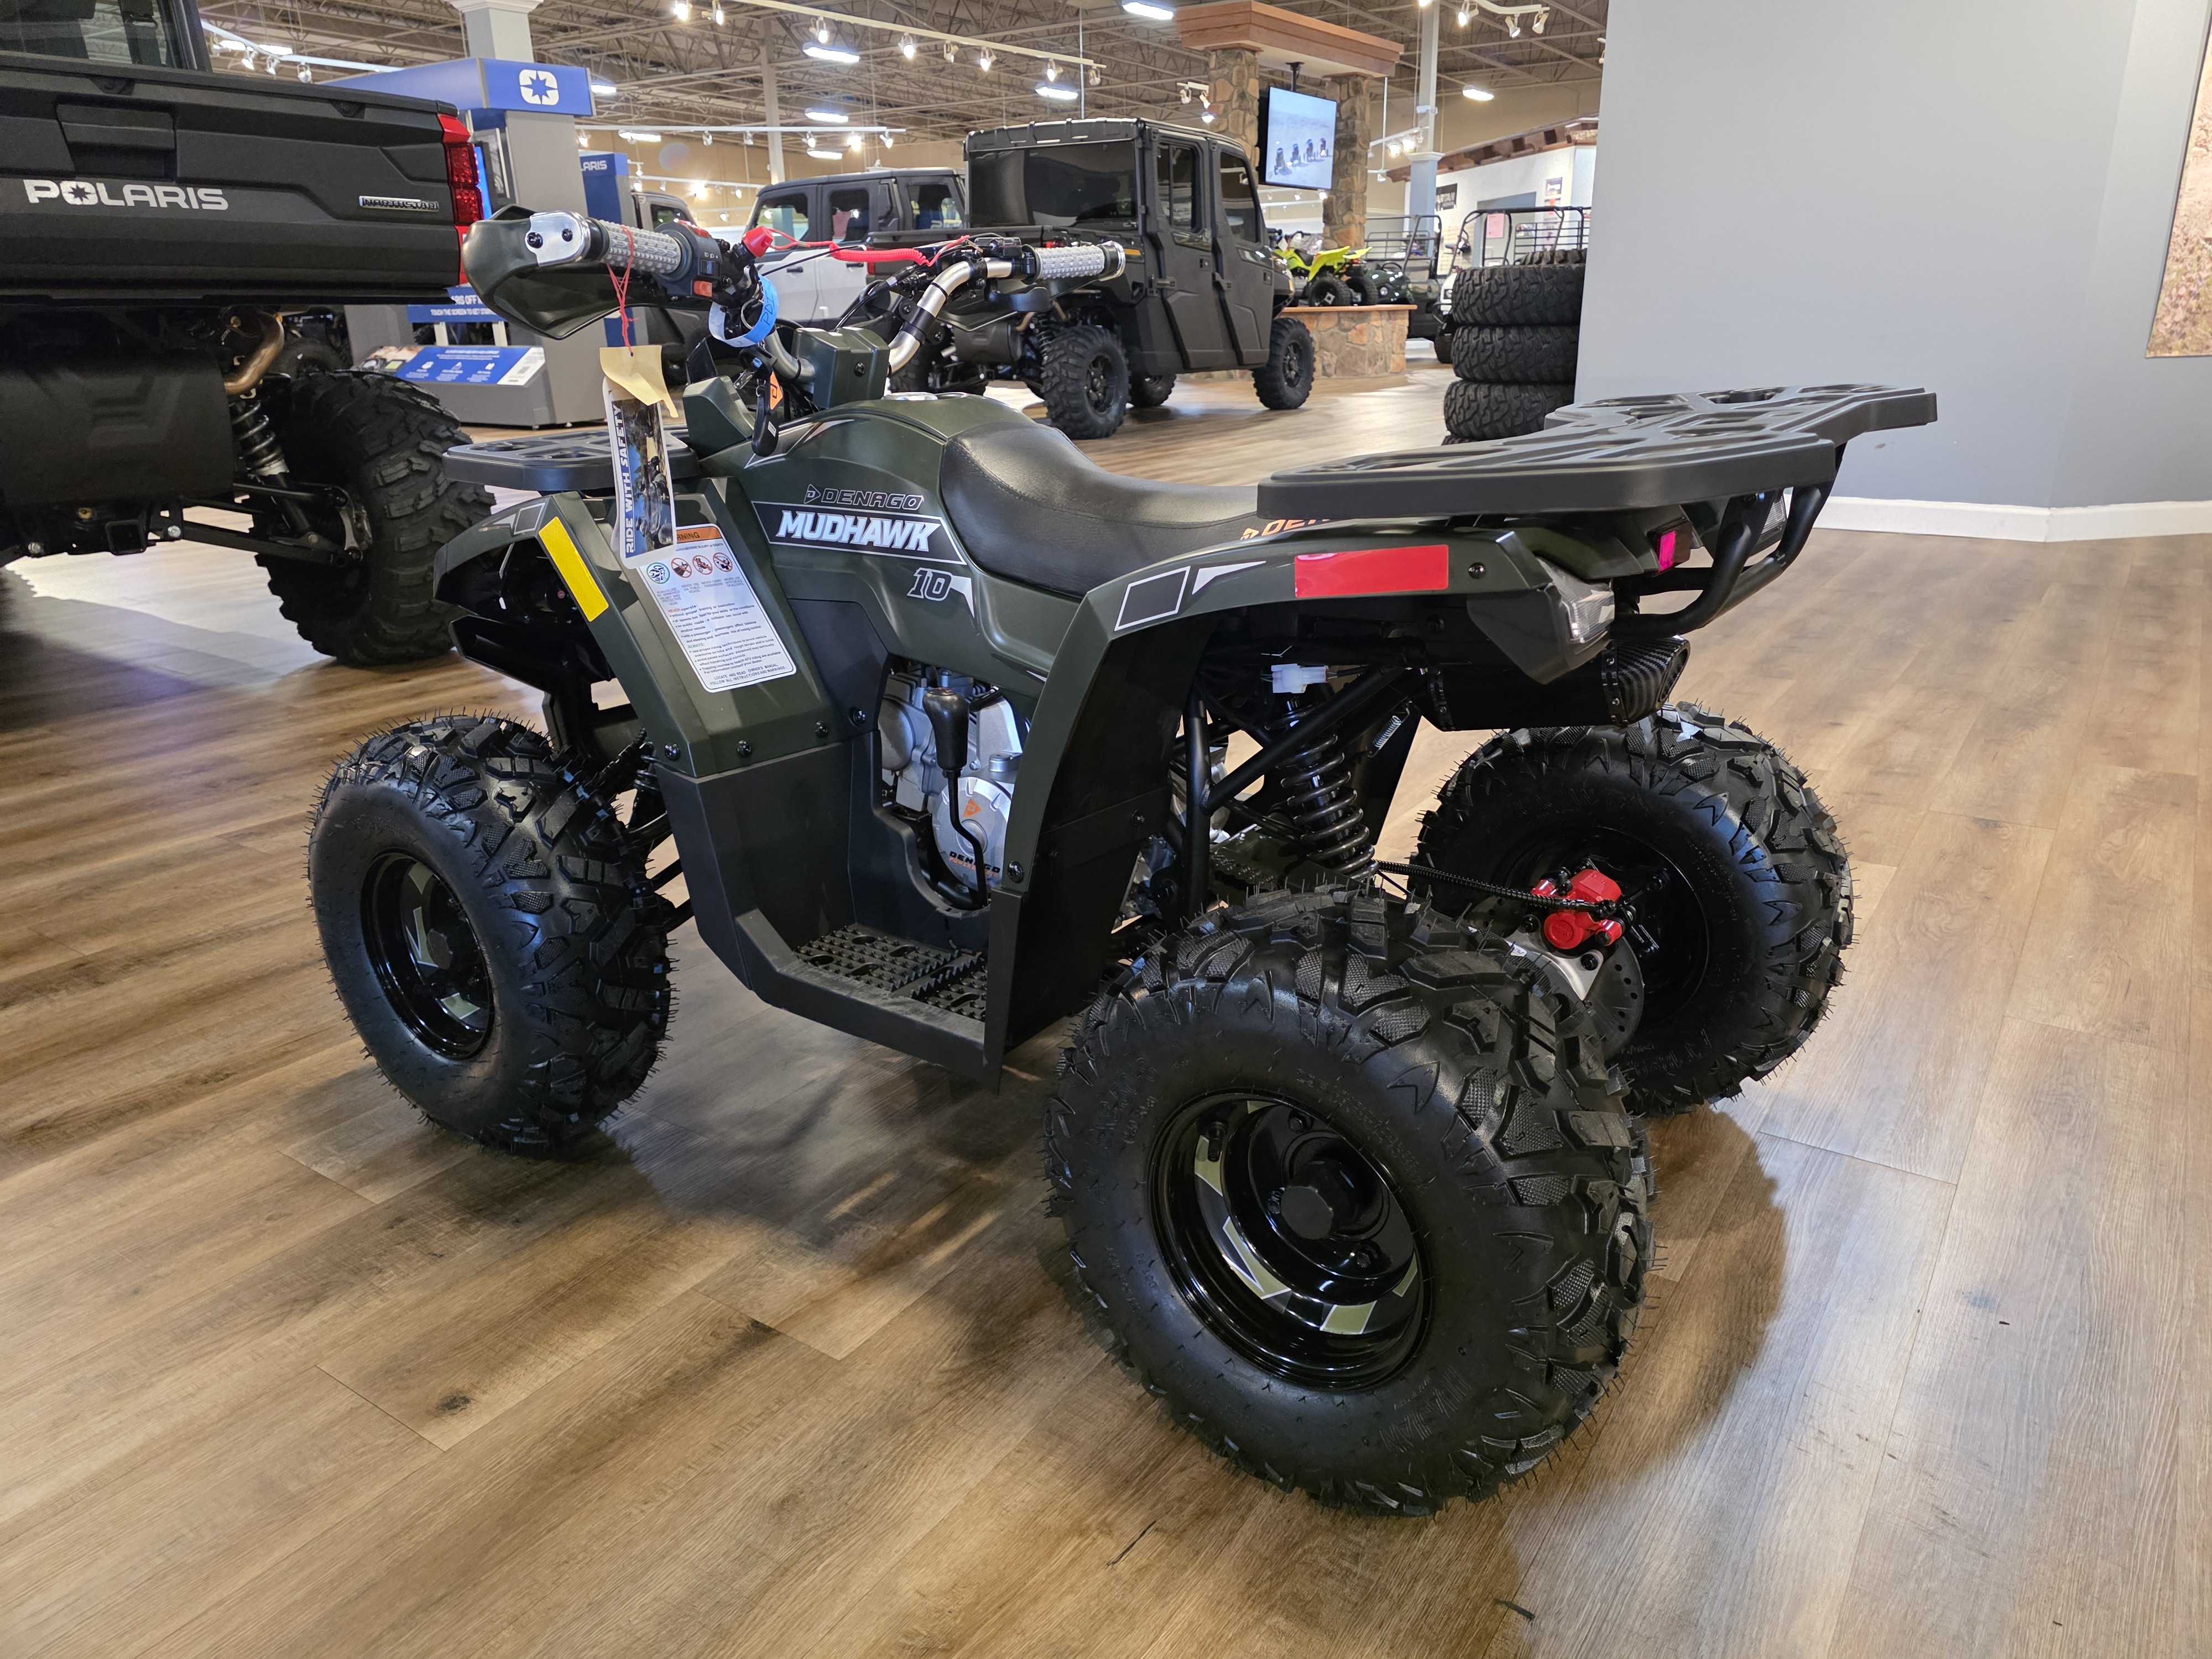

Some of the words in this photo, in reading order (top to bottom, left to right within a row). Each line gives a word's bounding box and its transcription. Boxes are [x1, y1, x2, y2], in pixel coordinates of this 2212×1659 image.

[581, 160, 607, 171] ARIS
[23, 179, 228, 210] POLARIS
[364, 199, 436, 210] NORTHSTAR
[760, 290, 775, 325] PDI
[613, 404, 628, 467] SAFETY
[622, 473, 633, 513] WITH
[821, 488, 924, 510] DENAGO
[626, 518, 634, 553] RIDE
[677, 532, 700, 540] RNING
[775, 510, 941, 552] MUDHAWK
[906, 567, 953, 601] 10
[733, 671, 760, 681] INSTRUCTIONS
[949, 851, 1000, 873] DENGO
